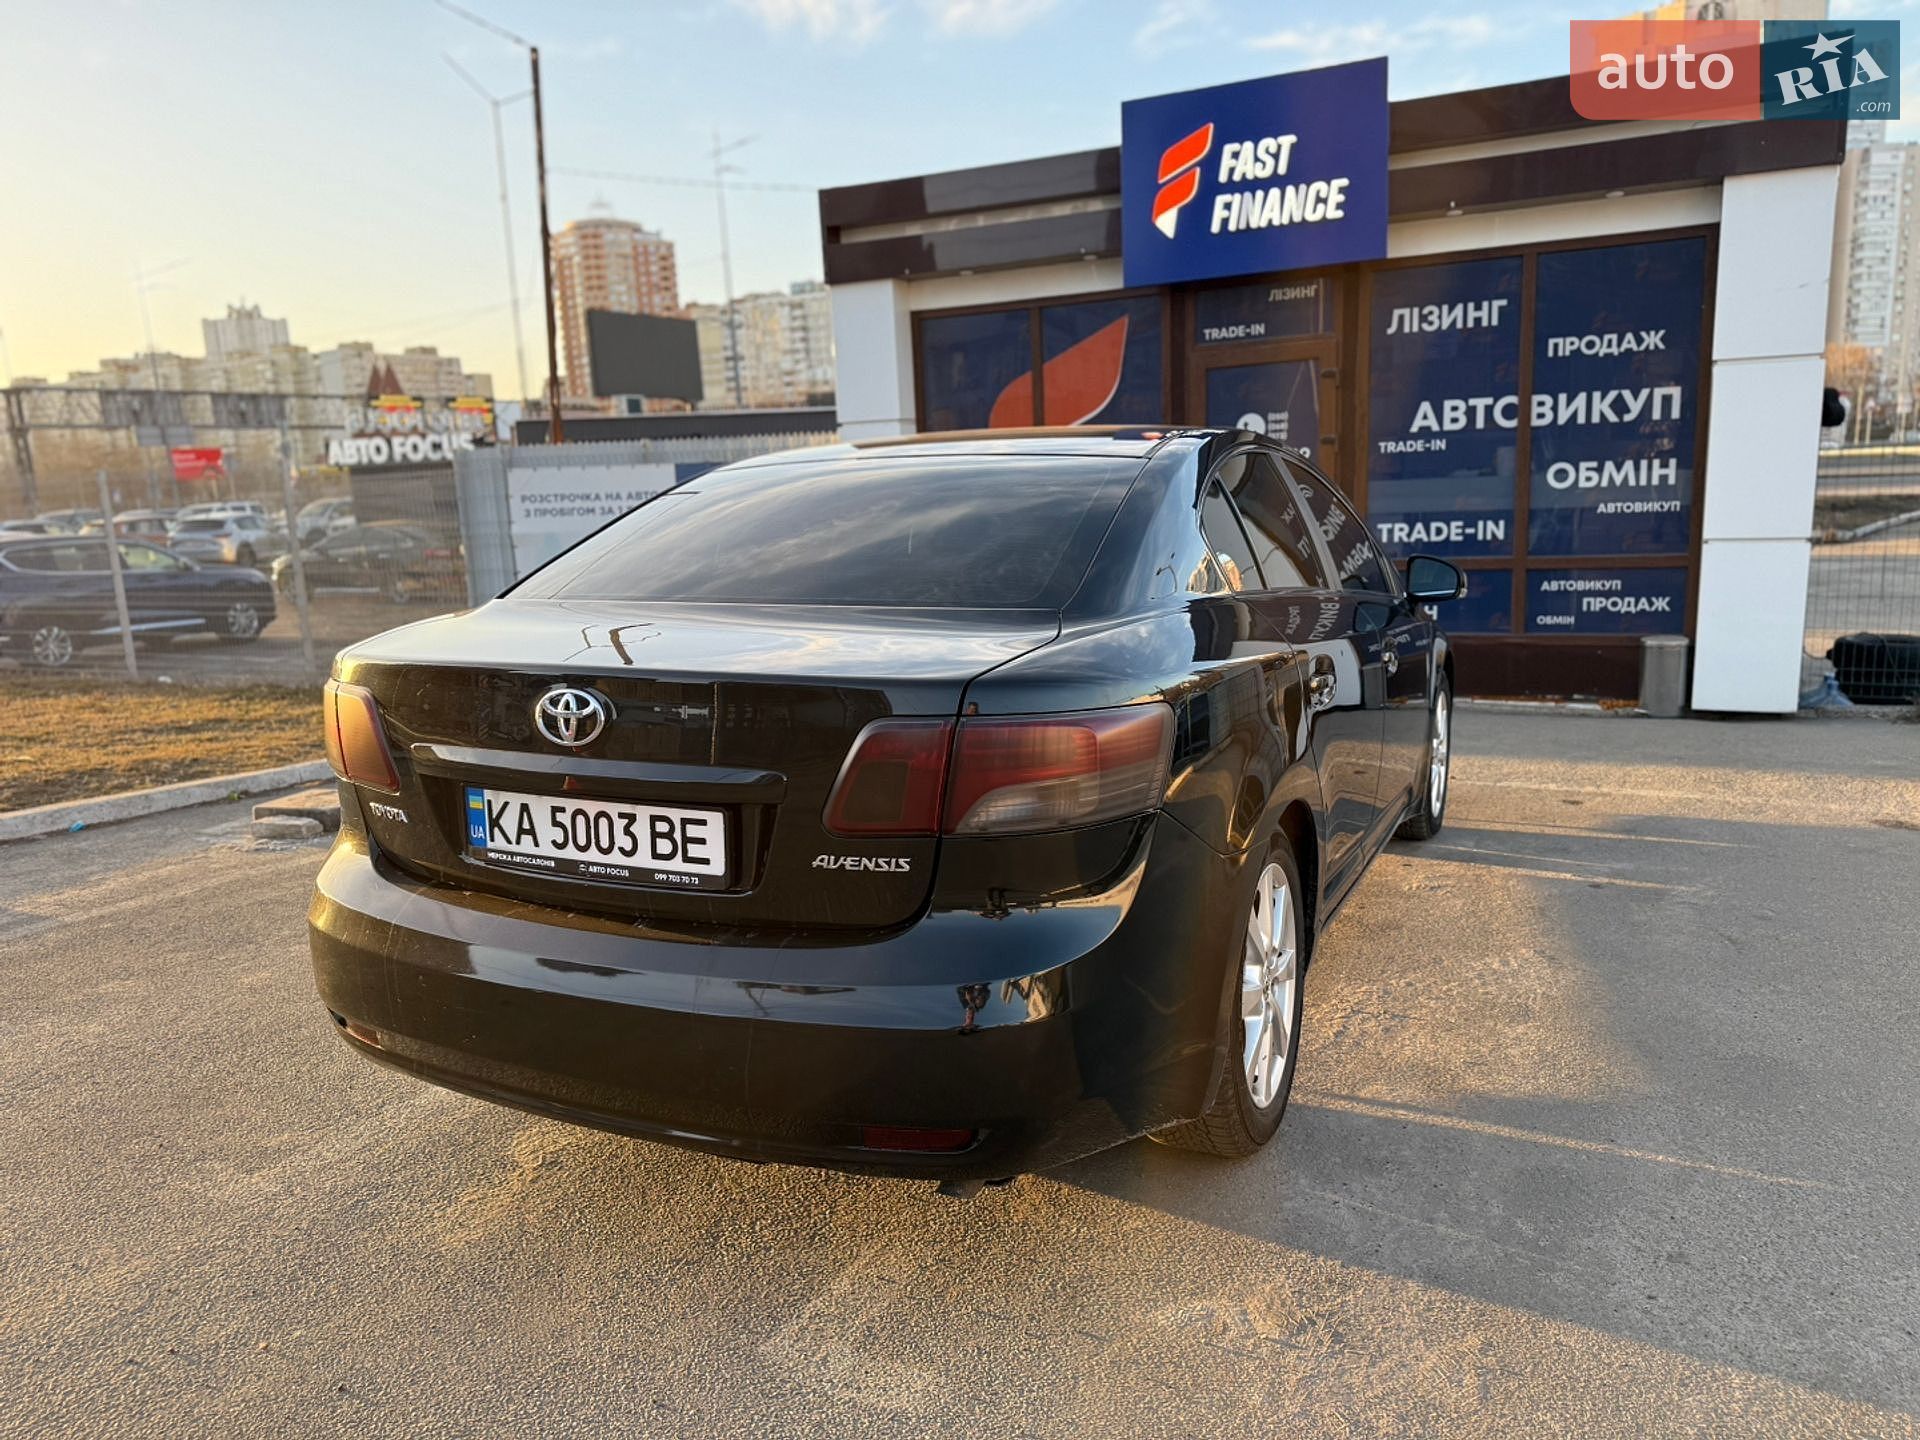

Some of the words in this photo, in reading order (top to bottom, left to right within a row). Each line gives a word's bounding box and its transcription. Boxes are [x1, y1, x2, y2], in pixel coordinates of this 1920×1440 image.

[1217, 134, 1298, 184] FAST
[1209, 177, 1350, 235] FINANCE
[1268, 284, 1319, 303] ЛІЗИНГ
[1386, 299, 1508, 335] ЛІЗИНГ
[1203, 323, 1266, 341] TRADE-IN
[1547, 329, 1667, 358] ПРОДАЖ
[1409, 386, 1682, 433] АВТОВИКУП
[390, 432, 476, 463] FOCUS
[1378, 438, 1447, 454] TRADE-IN
[1546, 458, 1677, 490] ОБМІН
[520, 492, 601, 505] РОЗСТРОЧКА
[605, 492, 622, 503] НА
[1597, 500, 1681, 514] АВТОВИКУП
[534, 507, 596, 518] ПРОБІГОМ
[1378, 519, 1506, 544] TRADE-IN
[1540, 580, 1622, 592] АВТОВИКУП
[1582, 597, 1671, 613] ПРОДАЖ
[1536, 615, 1575, 625] ОБМІН
[369, 802, 409, 824] TOYOTA
[469, 825, 485, 842] UA
[486, 798, 541, 850] KA
[549, 804, 639, 859] 5003
[650, 813, 712, 867] BE
[811, 853, 912, 873] AVENSIS
